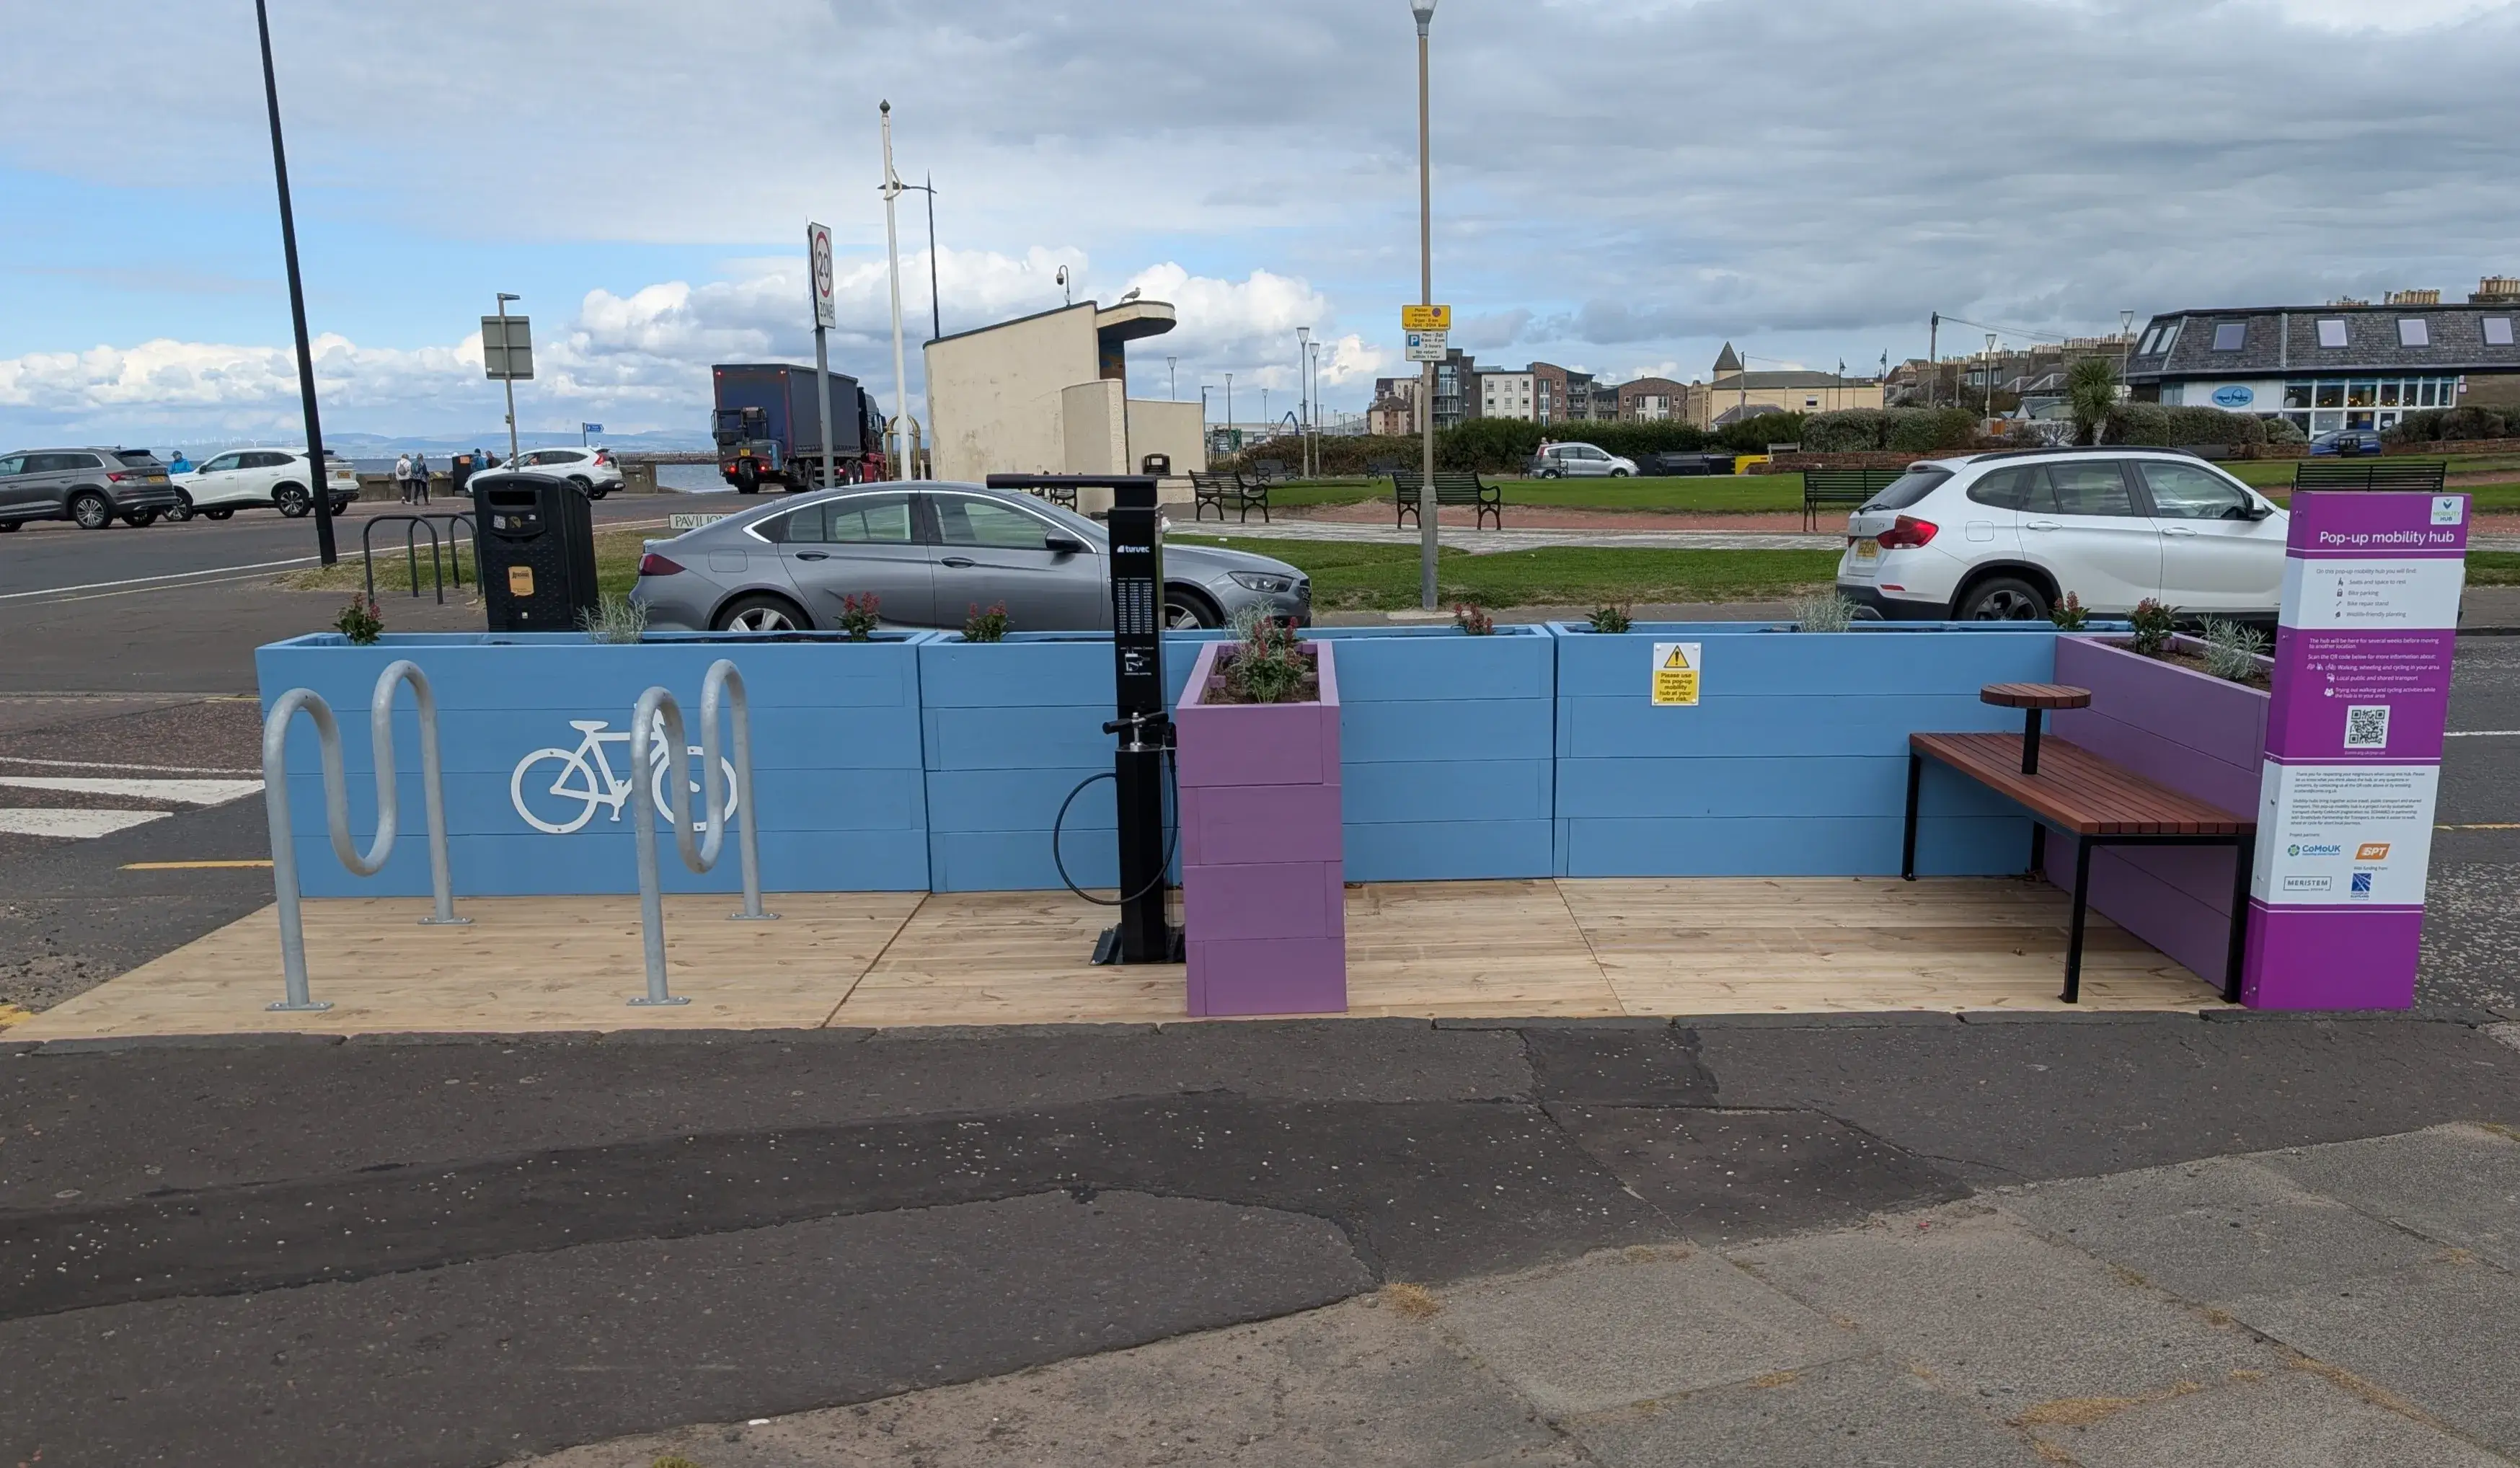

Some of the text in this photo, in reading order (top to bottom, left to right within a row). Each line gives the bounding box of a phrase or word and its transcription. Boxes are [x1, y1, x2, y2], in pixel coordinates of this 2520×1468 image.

[818, 250, 829, 278] 20
[819, 301, 834, 320] ZONE
[1410, 336, 1418, 345] P
[2320, 531, 2455, 546] Pop-up mobility hub
[2362, 847, 2386, 856] SPT
